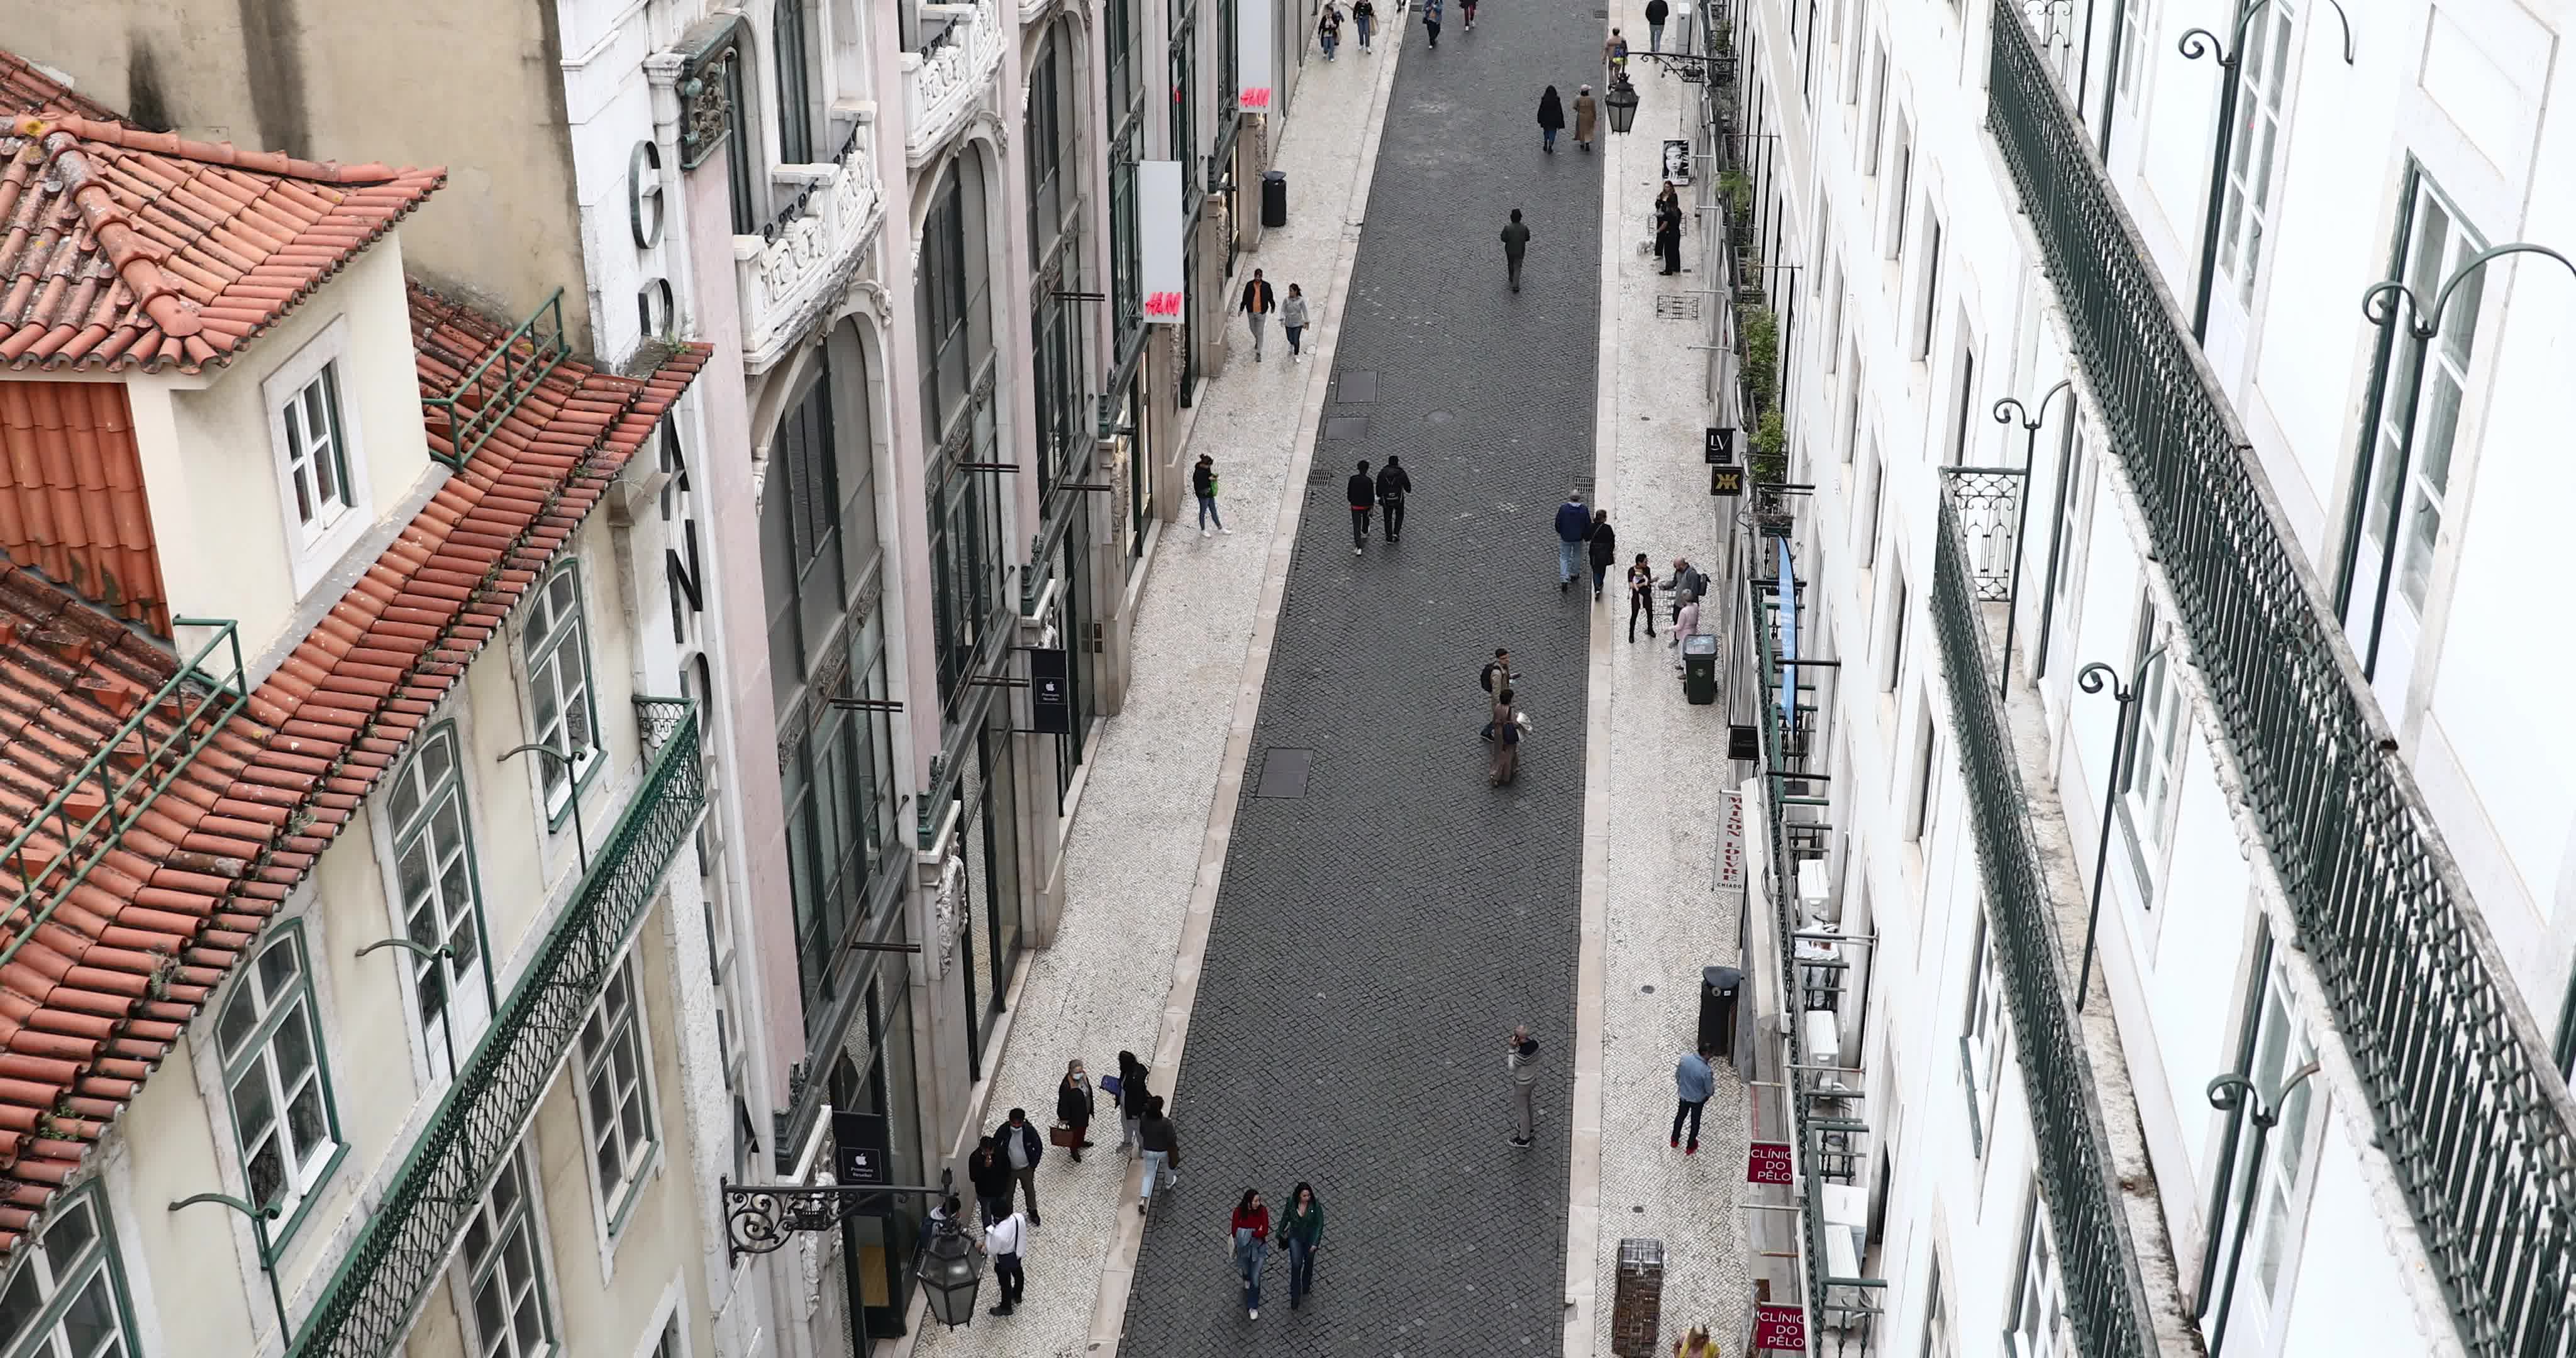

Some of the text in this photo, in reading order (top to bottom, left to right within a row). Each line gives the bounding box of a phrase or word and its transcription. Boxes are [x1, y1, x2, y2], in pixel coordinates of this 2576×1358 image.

[1240, 88, 1270, 107] H&M
[1145, 292, 1182, 316] H&M
[1751, 1148, 1791, 1160] CLÍNIC
[1765, 1161, 1786, 1170] DO
[1757, 1169, 1792, 1181] PÊLO
[1760, 1311, 1804, 1324] CLÍNIC
[1776, 1325, 1798, 1335] DO
[1767, 1335, 1804, 1347] PÊLO
